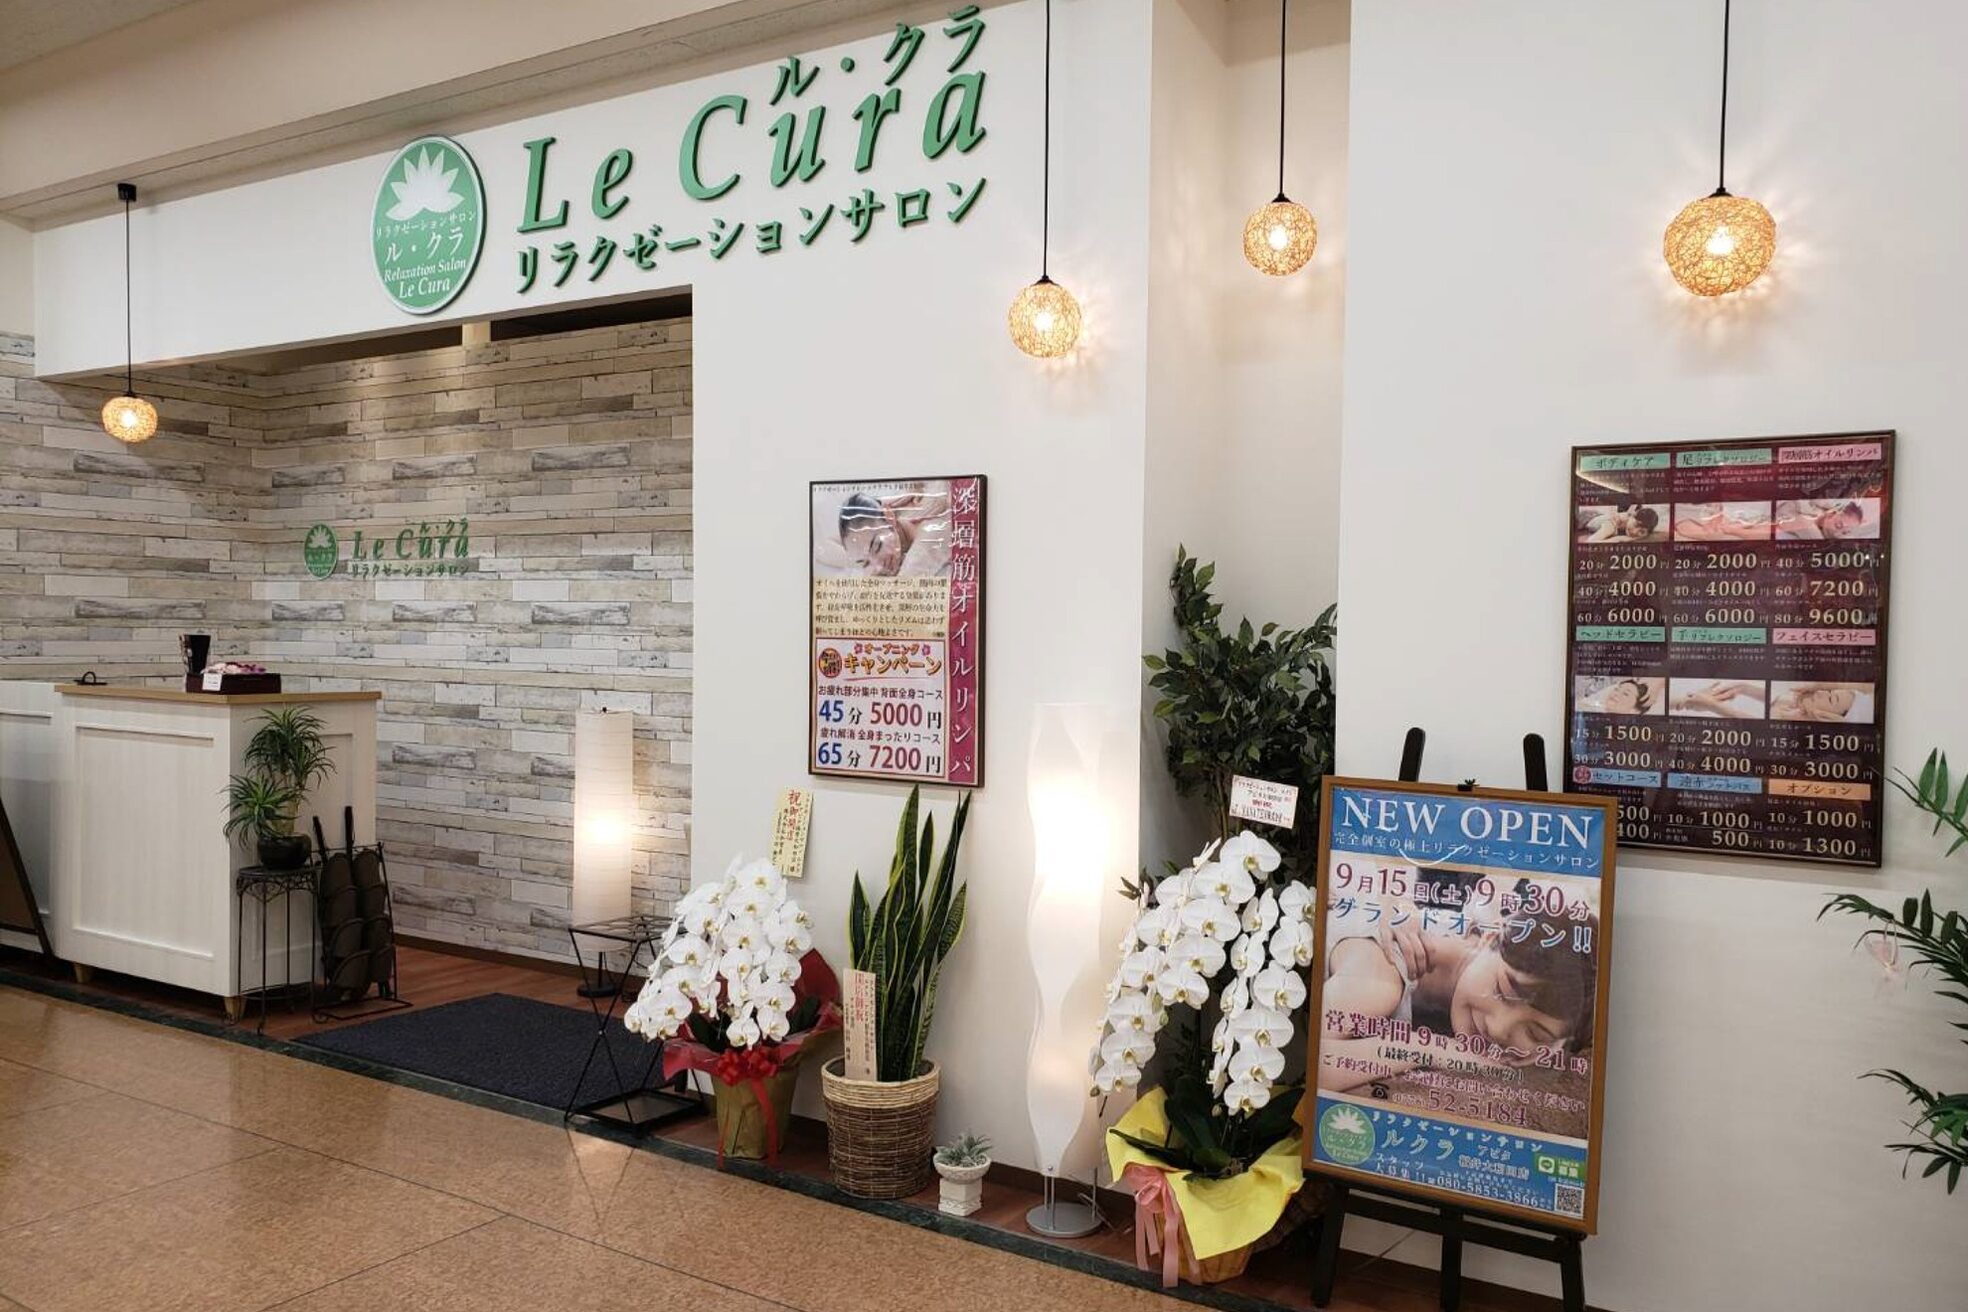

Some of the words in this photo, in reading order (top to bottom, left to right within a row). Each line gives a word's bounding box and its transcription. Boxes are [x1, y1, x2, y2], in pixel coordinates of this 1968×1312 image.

[768, 4, 987, 105] ル・クラ
[516, 136, 633, 235] Le
[678, 70, 988, 202] Cura
[376, 210, 477, 241] リラクゼーションサロン
[515, 177, 988, 294] リラクゼーションサロン
[384, 226, 464, 265] ル・クラ
[384, 263, 436, 282] Relaxation
[437, 257, 467, 273] Salon
[399, 281, 415, 298] Le
[418, 276, 451, 296] Cura
[353, 530, 385, 560] Le
[396, 528, 469, 559] Cura
[352, 563, 469, 578] リラクゼーションサロン
[1580, 629, 1661, 640] ヘッドセラピー
[1776, 631, 1873, 641] フェイスセラピー
[844, 652, 942, 676] キャンペーン
[858, 729, 941, 745] 全身まったりコース
[1786, 782, 1852, 796] オプション
[1341, 795, 1447, 836] NEW
[1460, 806, 1593, 851] OPEN
[1325, 1009, 1411, 1045] 営業時間
[1381, 1129, 1455, 1161] ルクラ
[1436, 1175, 1539, 1208] 080-5853-3866
